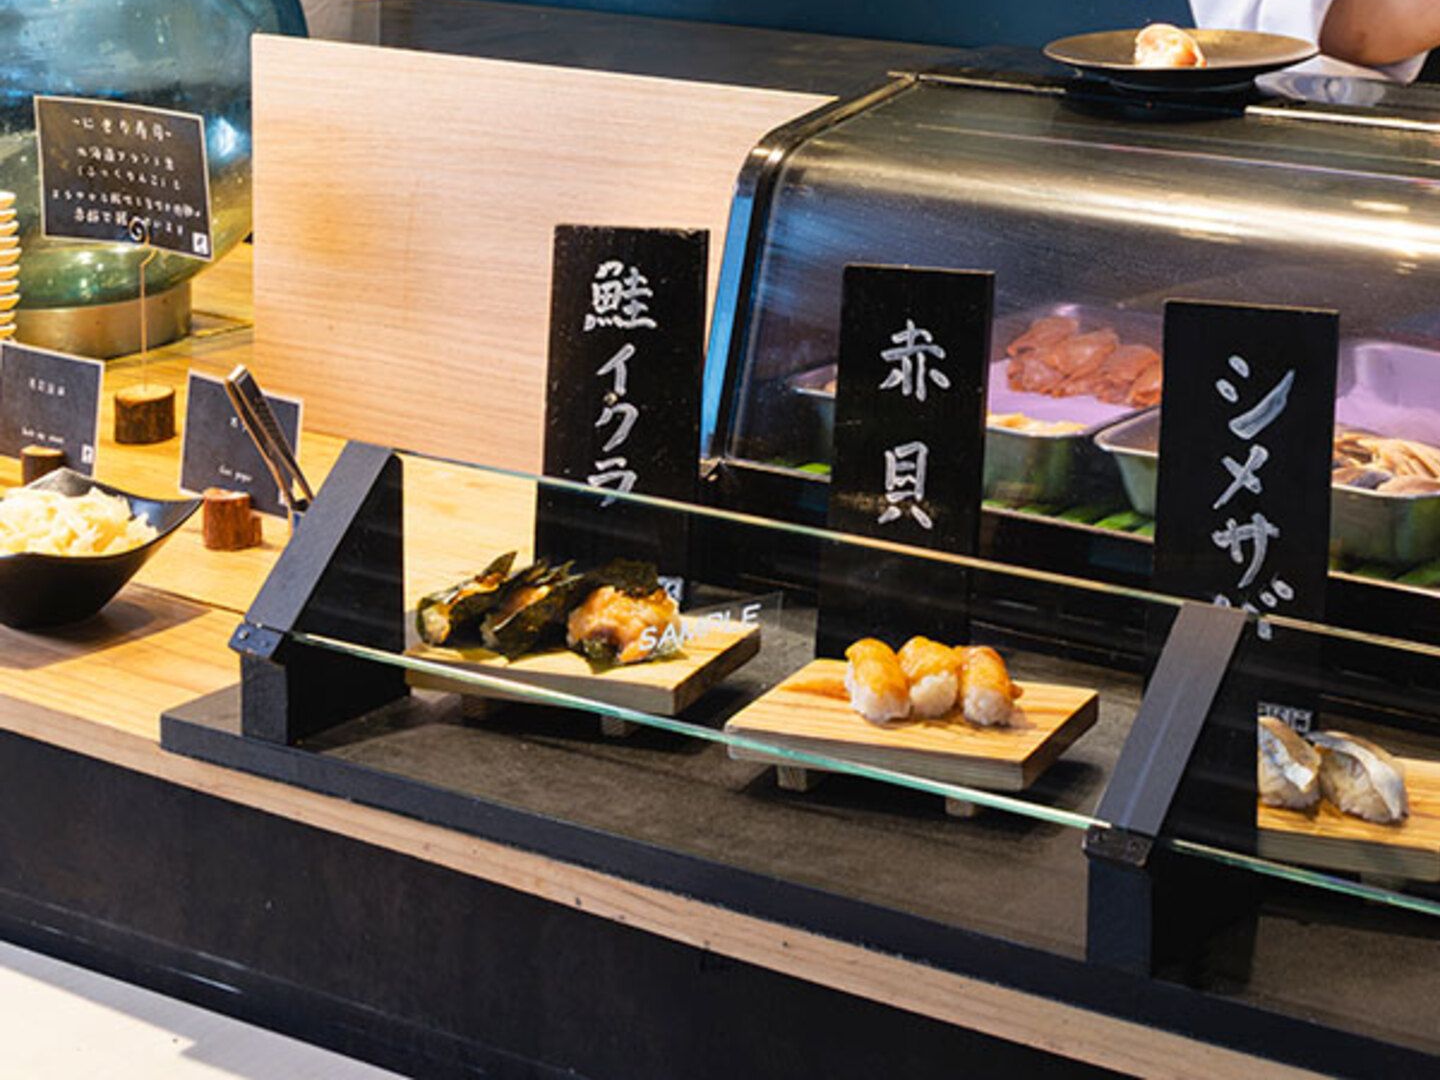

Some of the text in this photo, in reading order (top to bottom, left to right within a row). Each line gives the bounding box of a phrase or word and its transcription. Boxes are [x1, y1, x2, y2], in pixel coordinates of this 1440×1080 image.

[583, 259, 659, 508] 鮭イクラ
[877, 319, 951, 530] 赤貝
